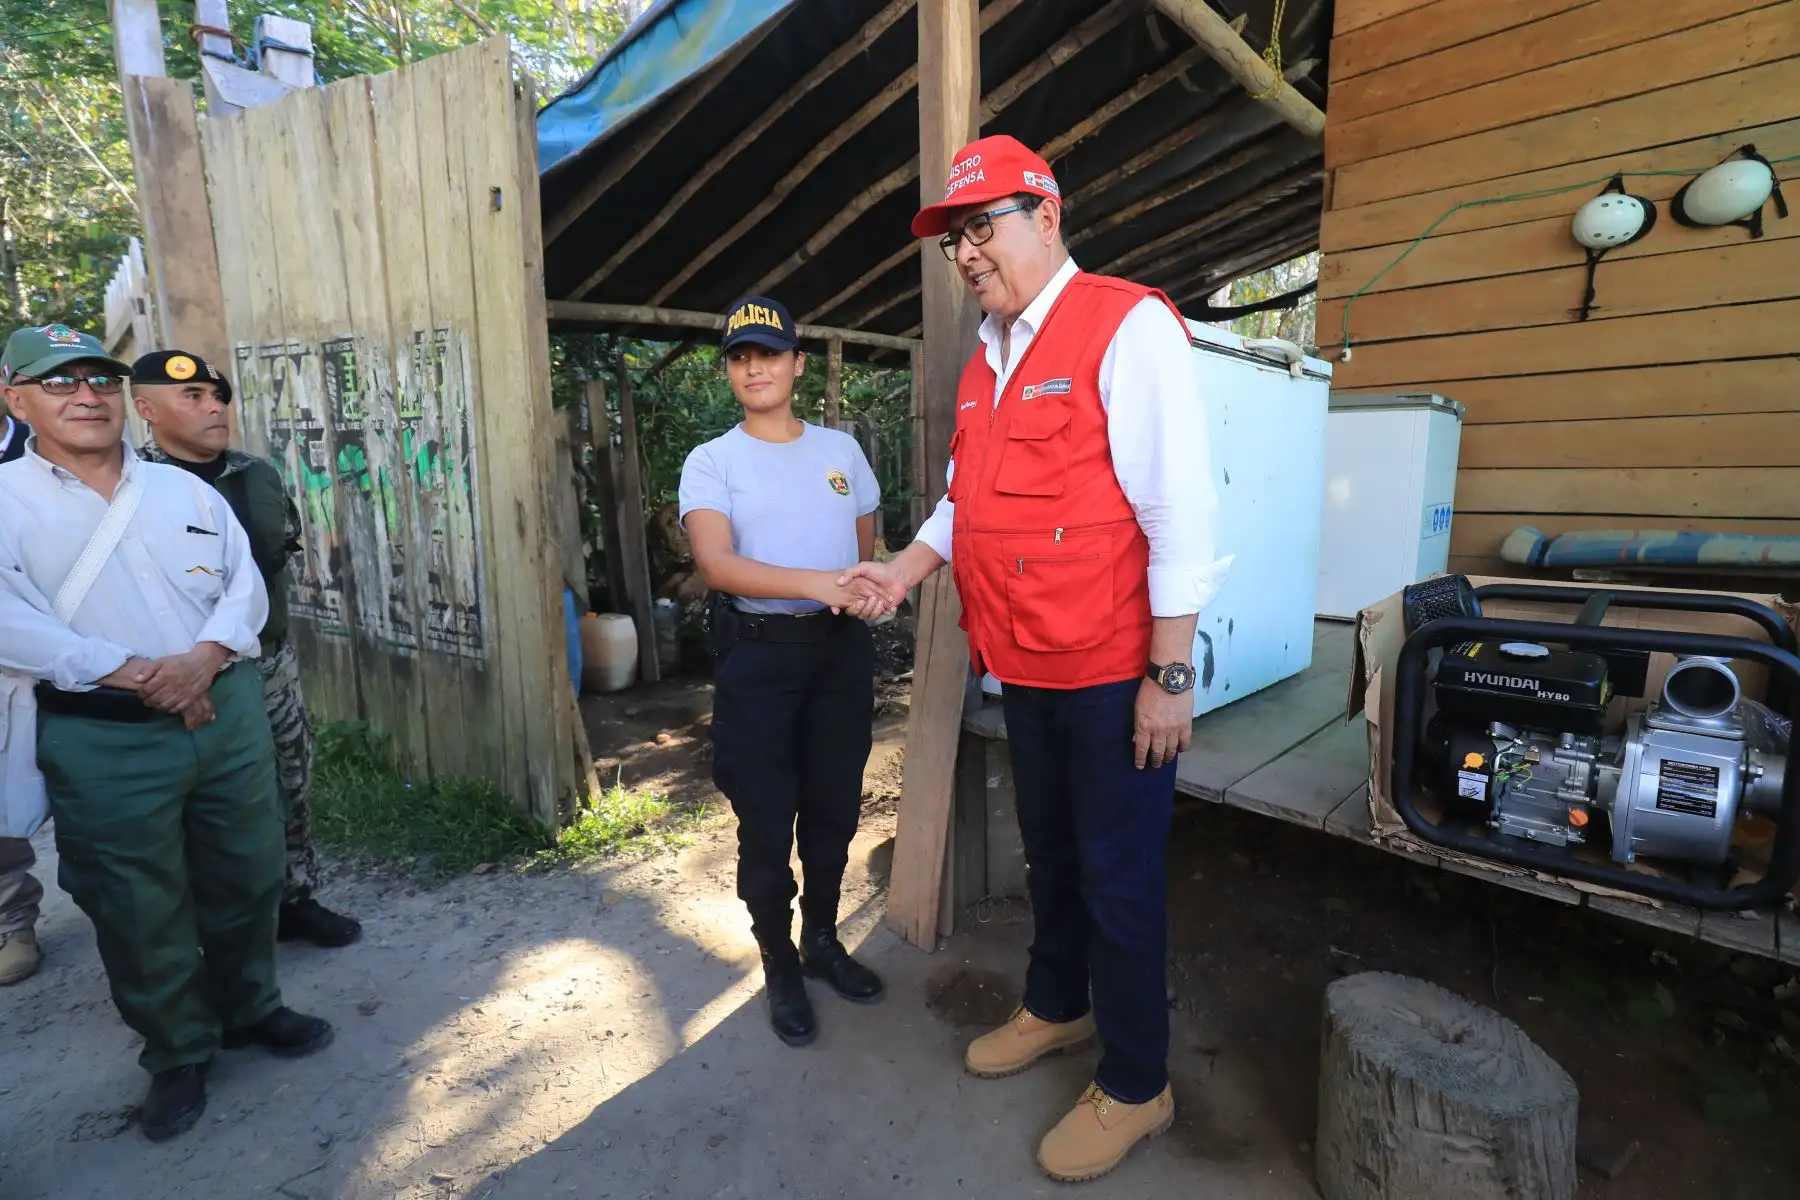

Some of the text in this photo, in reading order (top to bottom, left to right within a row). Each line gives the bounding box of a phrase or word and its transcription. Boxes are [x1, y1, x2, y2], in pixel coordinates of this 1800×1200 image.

[726, 303, 784, 337] POLICIA
[1464, 672, 1540, 690] HYUNDAI
[1537, 690, 1570, 701] HY80
